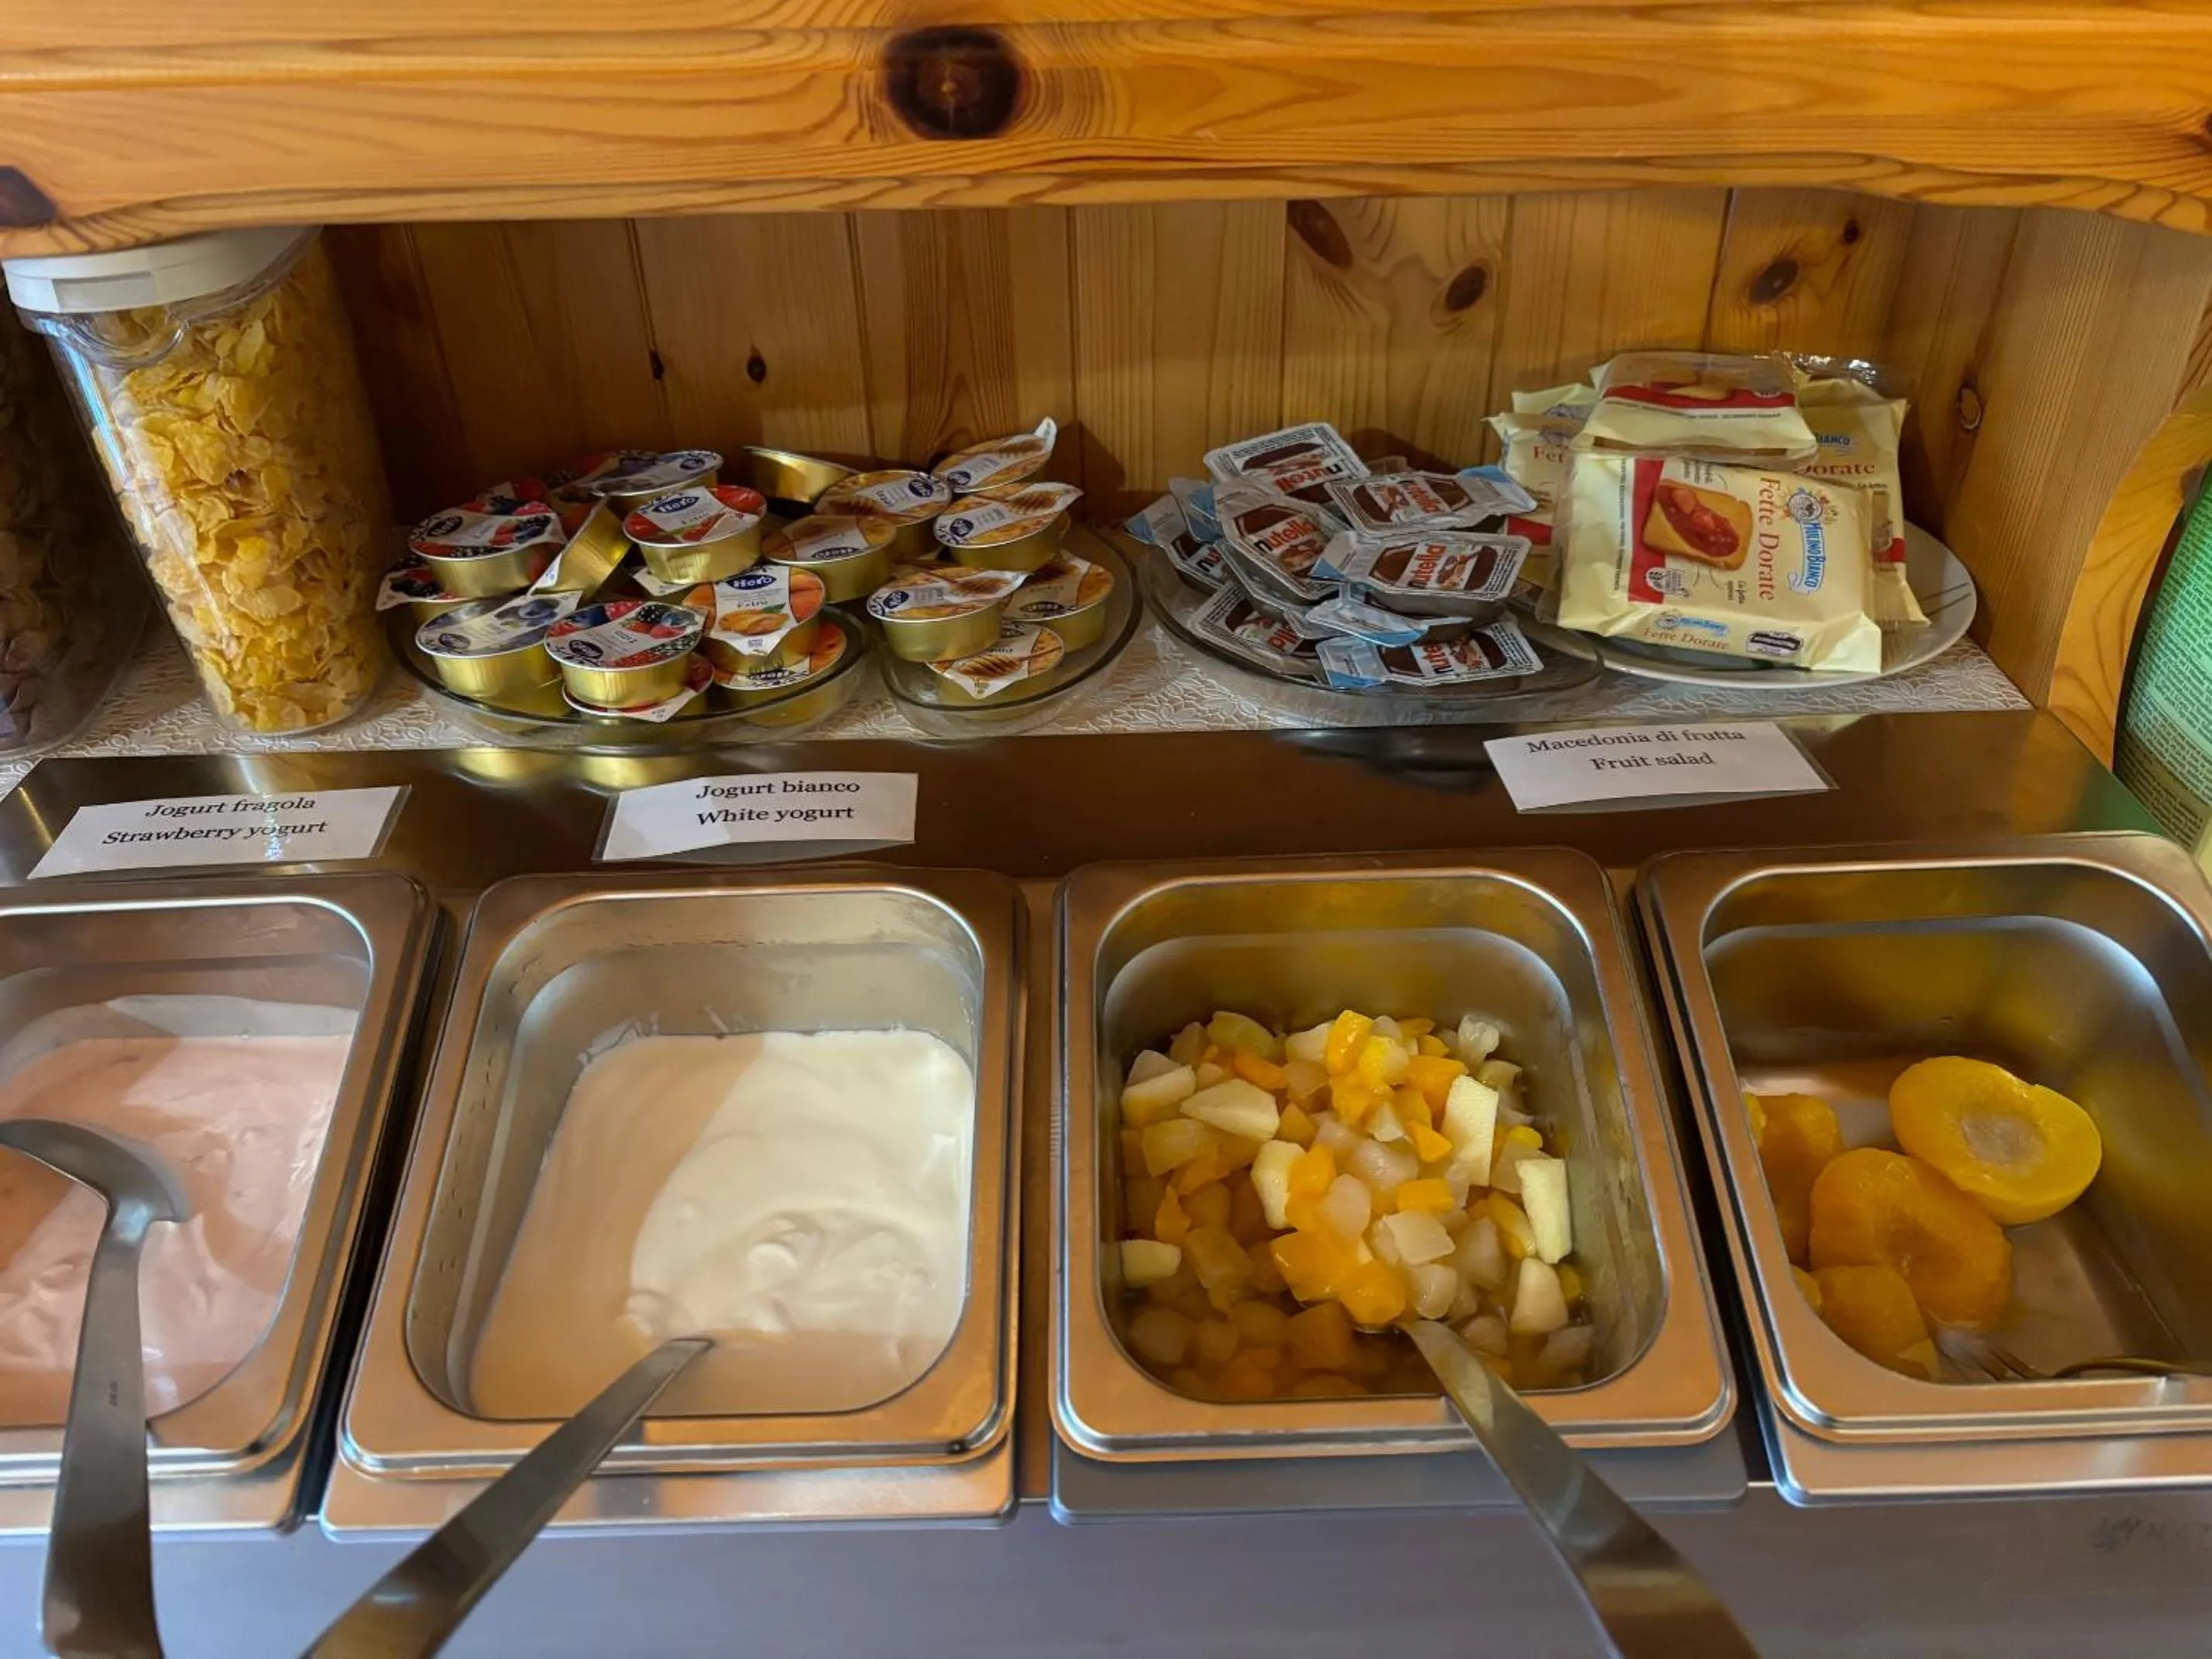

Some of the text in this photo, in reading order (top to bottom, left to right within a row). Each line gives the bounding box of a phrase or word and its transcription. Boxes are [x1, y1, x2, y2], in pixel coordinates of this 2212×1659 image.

[1534, 445, 1564, 463] Fet
[659, 496, 696, 513] Hero
[1757, 477, 1781, 601] Fette Dorate
[1408, 544, 1448, 589] nutella
[733, 575, 773, 589] Hero
[1680, 633, 1729, 650] Dorate
[1526, 729, 1746, 754] Macedonia di frutta
[1590, 752, 1715, 771] Fruit salad
[696, 781, 860, 799] Jogurt bianco
[145, 795, 316, 819] Jogurt fragola
[696, 807, 854, 825] White yogurt
[101, 819, 328, 846] Strawberry yogurt
